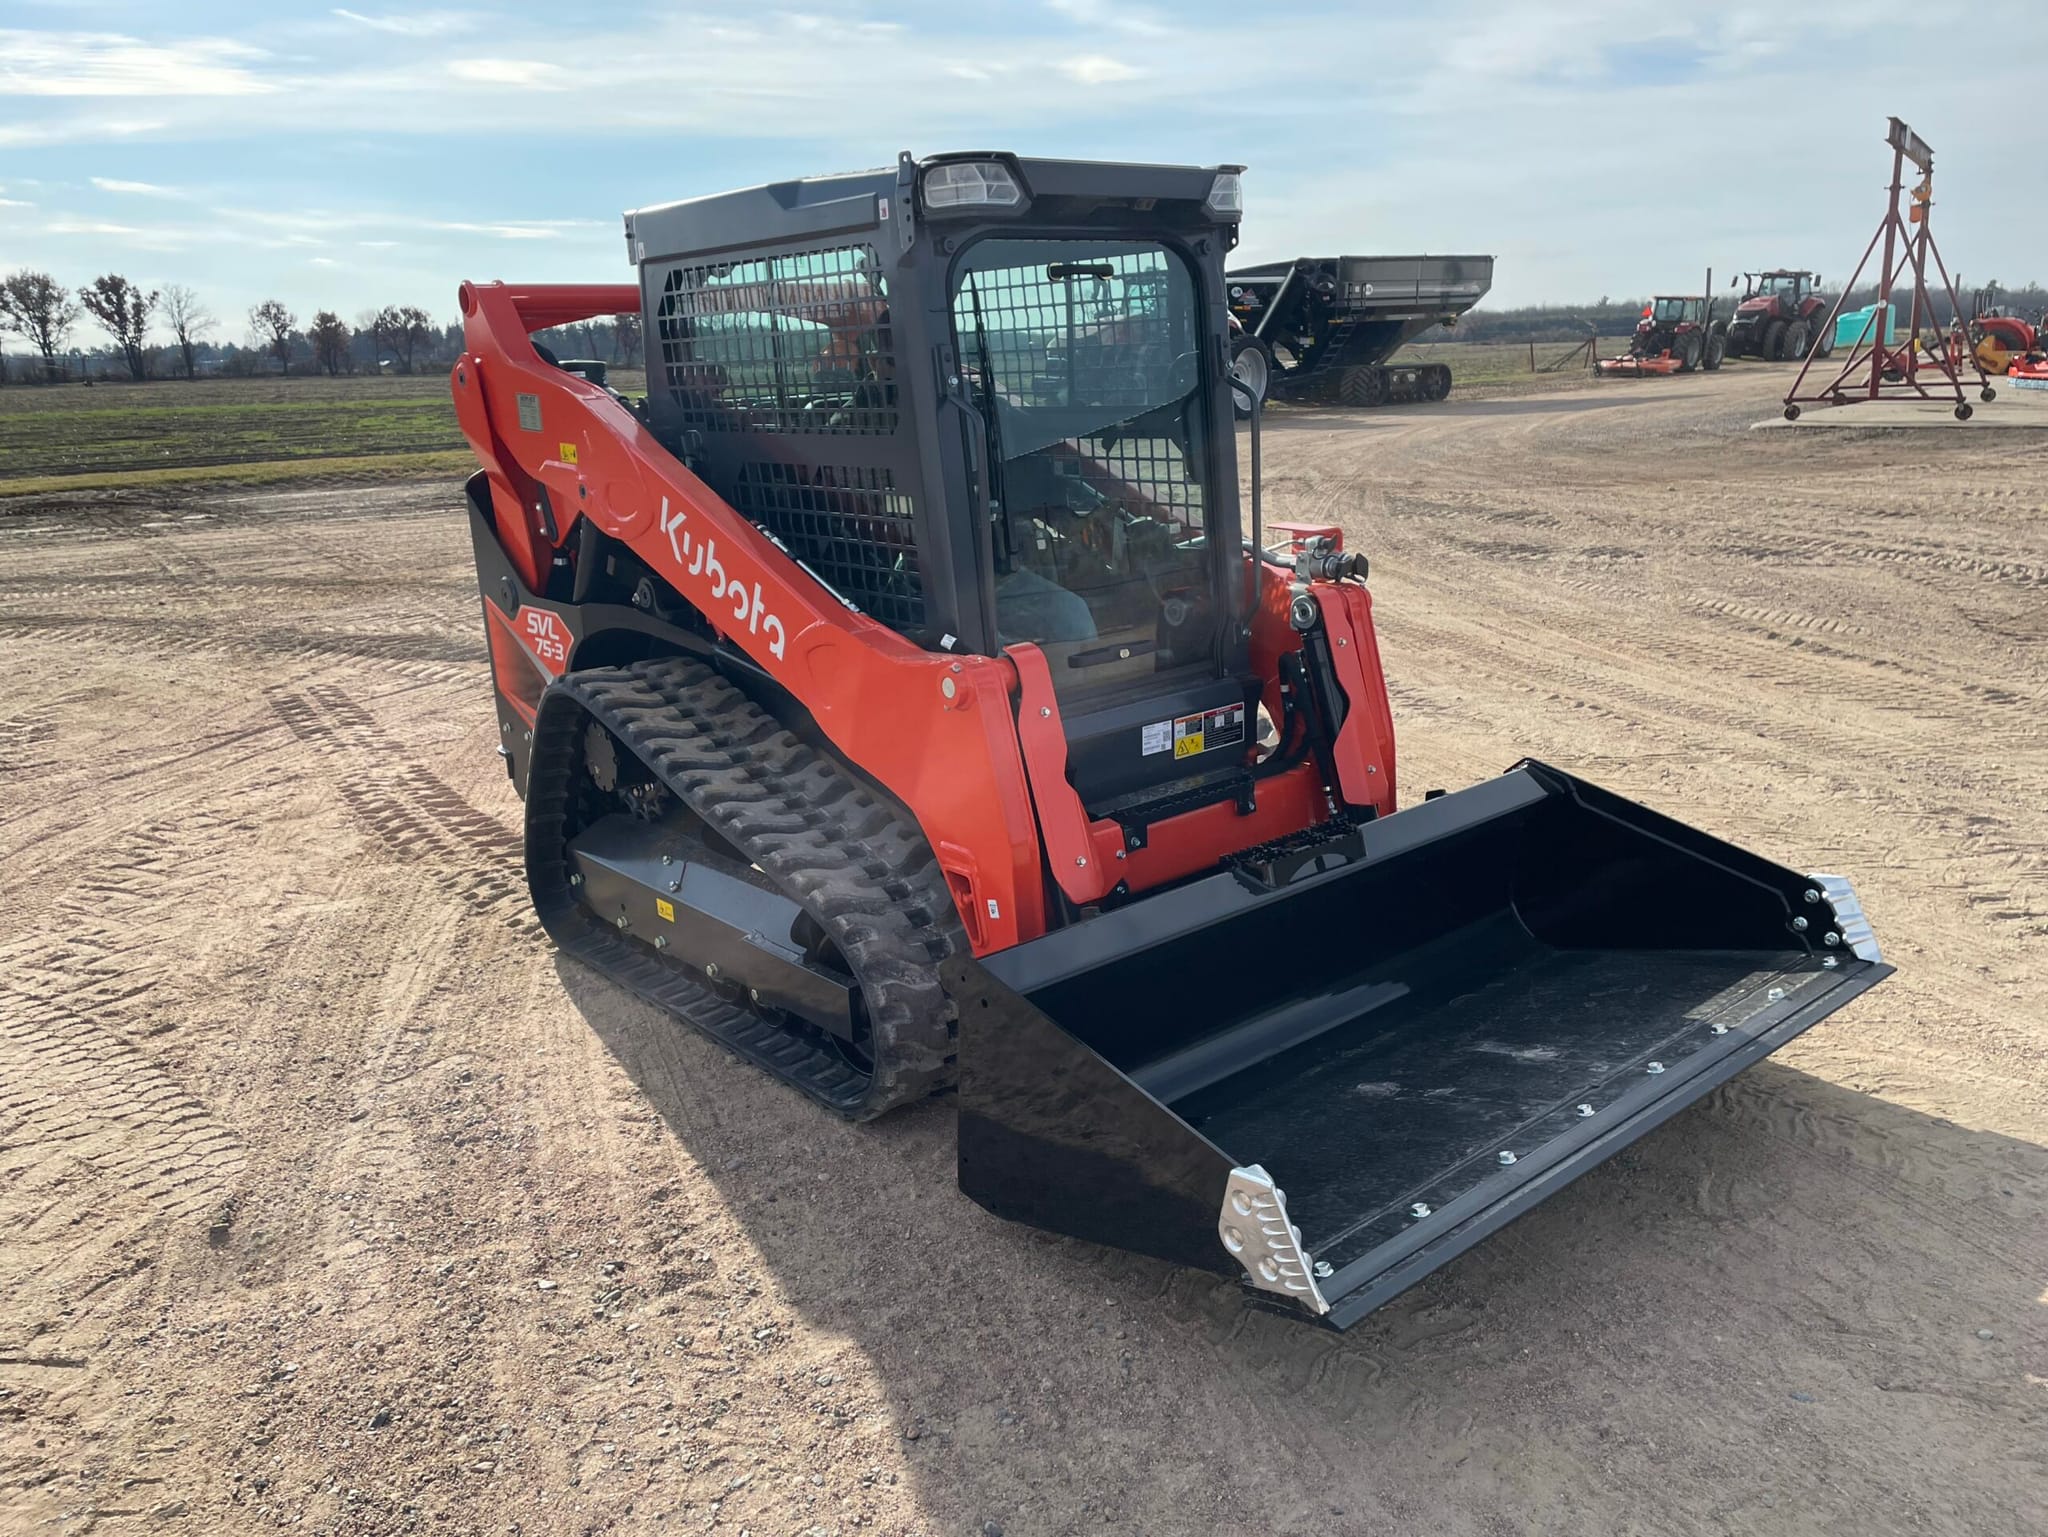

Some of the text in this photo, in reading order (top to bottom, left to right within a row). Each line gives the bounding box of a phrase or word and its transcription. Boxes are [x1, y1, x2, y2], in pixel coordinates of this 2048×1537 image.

[660, 496, 785, 660] Kubota
[527, 612, 559, 640] SVL
[535, 638, 564, 661] 75-3
